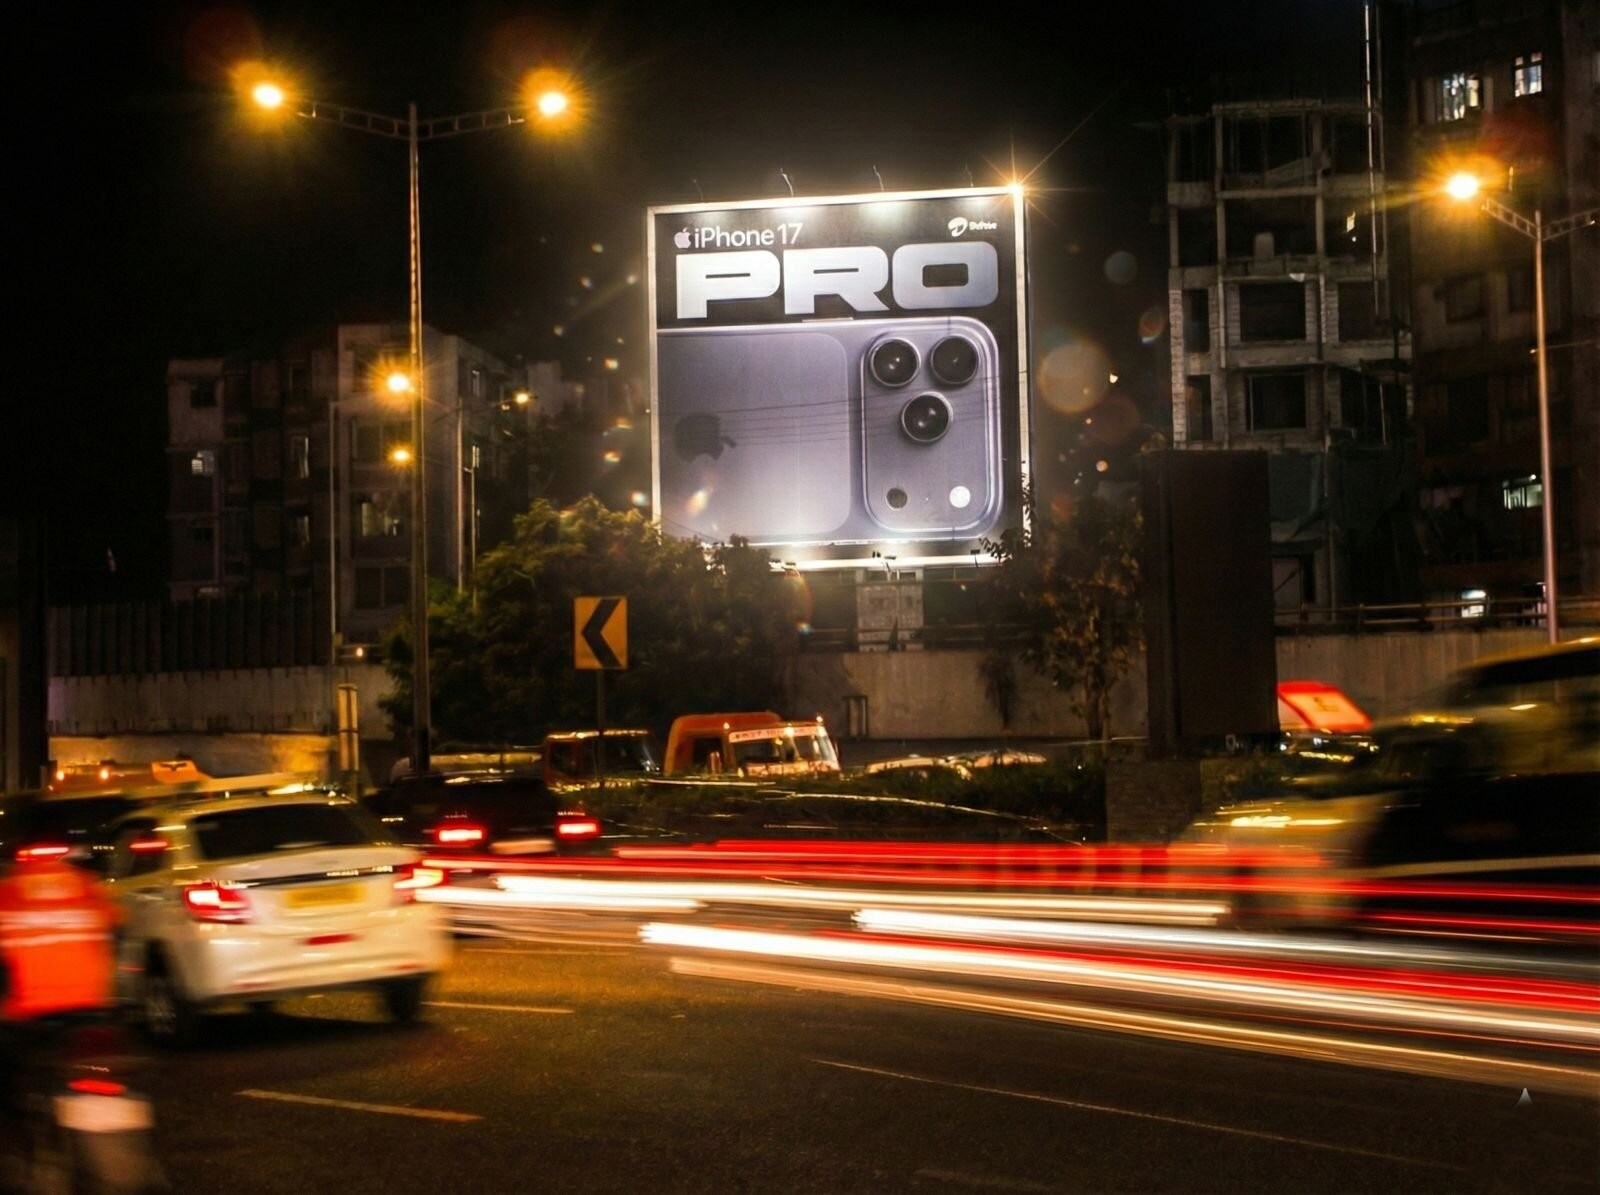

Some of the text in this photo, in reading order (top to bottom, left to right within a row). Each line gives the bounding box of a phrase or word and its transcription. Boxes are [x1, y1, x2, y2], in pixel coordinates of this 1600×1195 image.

[694, 222, 803, 248] iPhone 17
[676, 241, 999, 319] PRO
